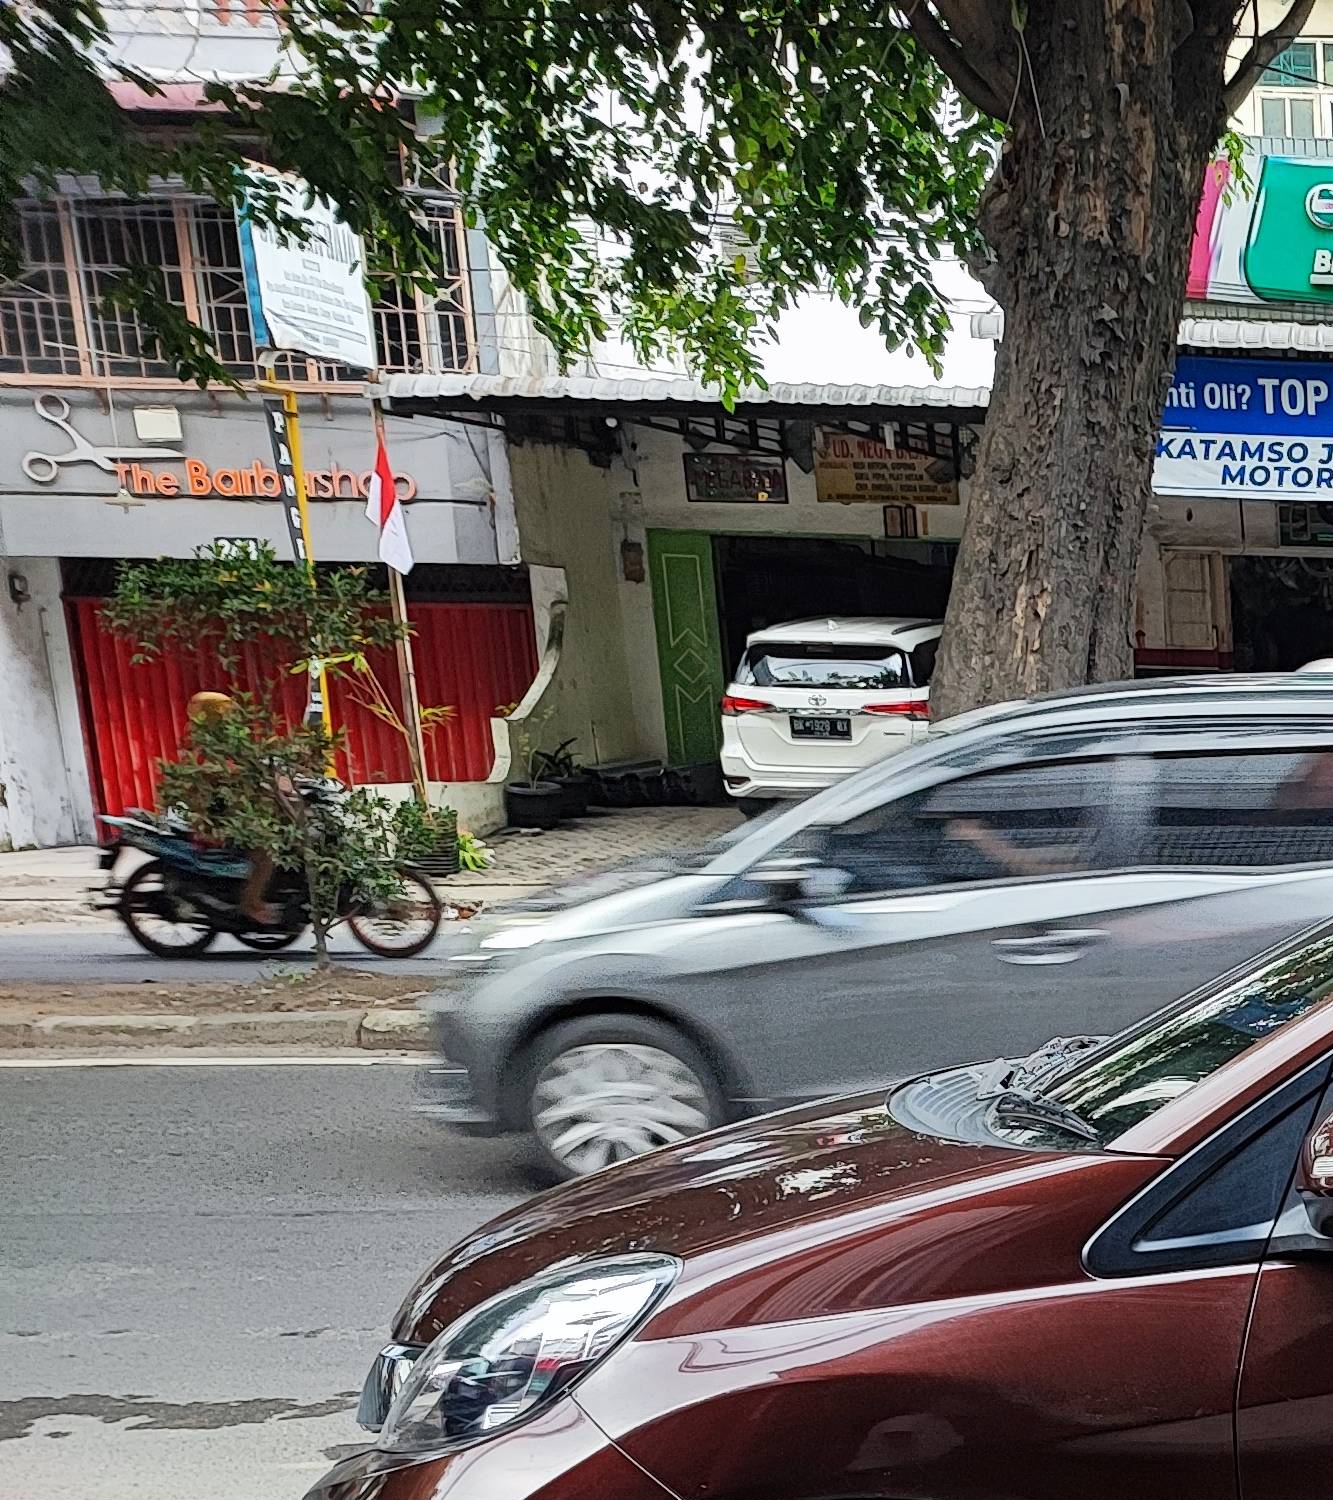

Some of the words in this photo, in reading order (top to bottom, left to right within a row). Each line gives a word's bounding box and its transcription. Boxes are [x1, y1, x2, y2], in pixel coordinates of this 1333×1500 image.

[1203, 383, 1252, 410] Oli?
[1257, 378, 1329, 416] TOP
[1156, 437, 1309, 464] KATAMSO
[113, 463, 181, 496] The
